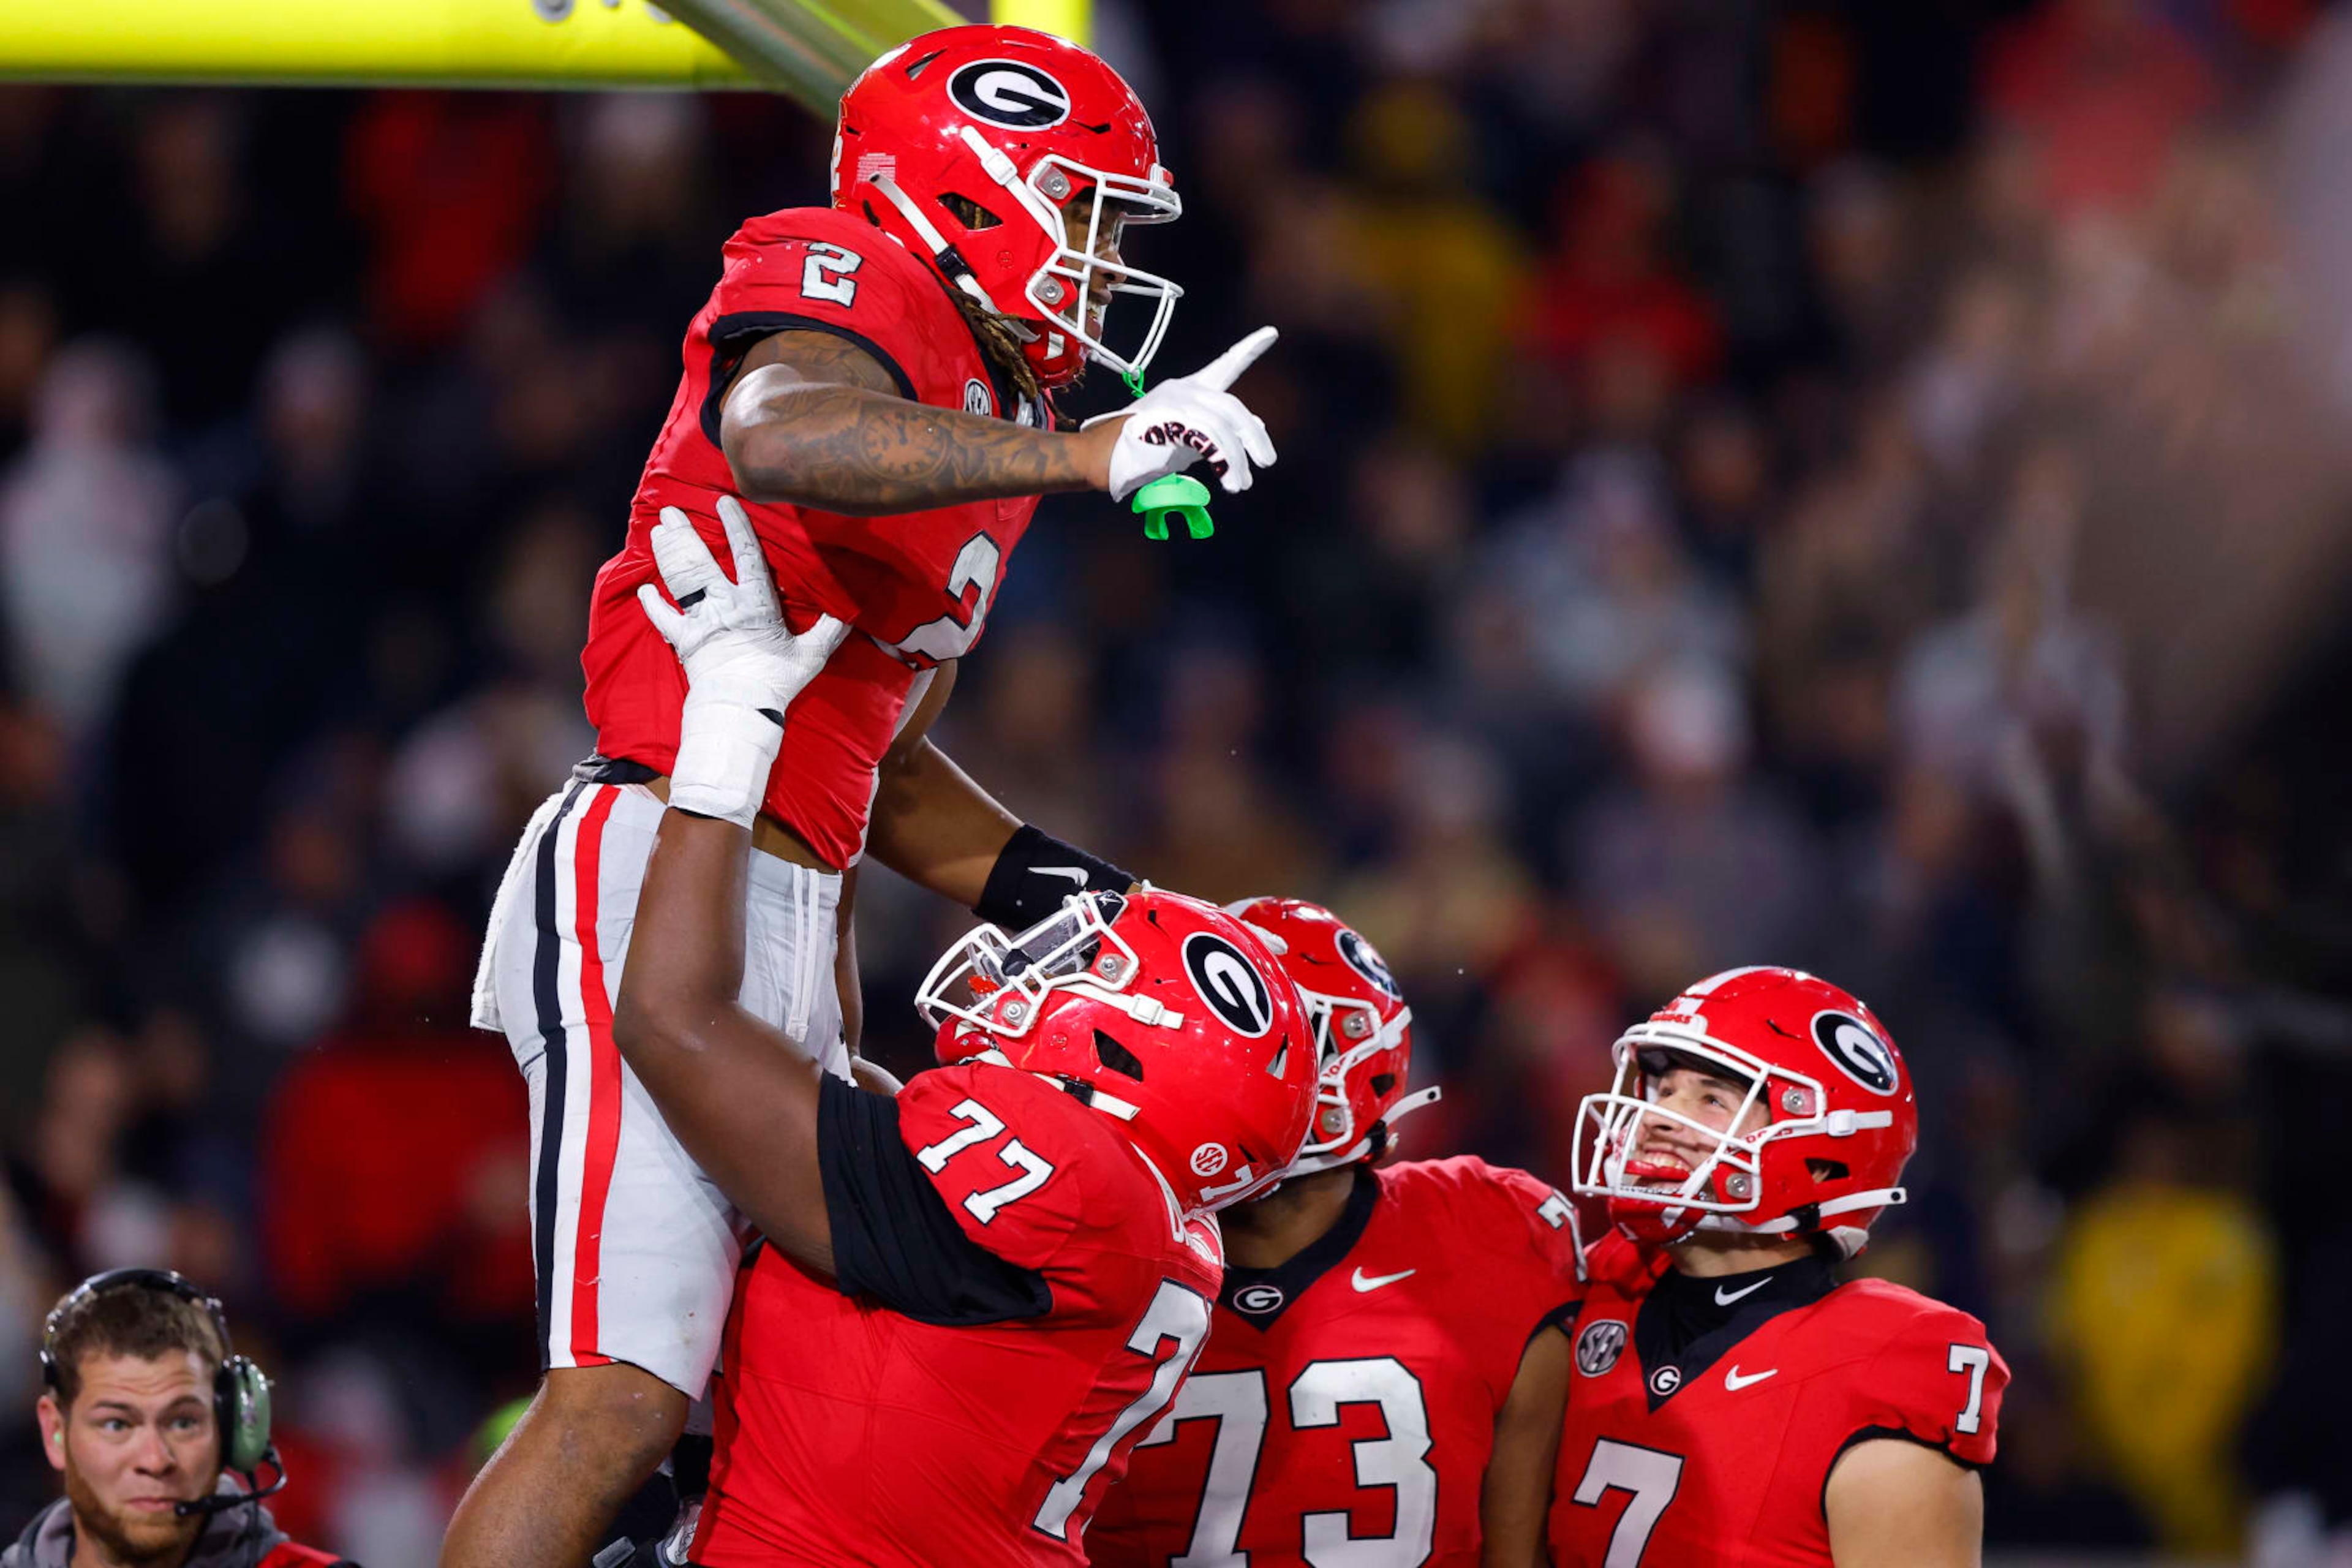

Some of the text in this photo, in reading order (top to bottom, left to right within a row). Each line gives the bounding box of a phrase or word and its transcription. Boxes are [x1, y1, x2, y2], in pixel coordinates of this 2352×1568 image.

[951, 62, 1068, 127] G
[800, 241, 864, 310] 2
[1139, 421, 1229, 480] ORGIA
[1193, 532, 1225, 562] SEC
[891, 529, 1001, 663] 2
[1186, 935, 1269, 1034] G
[1815, 1014, 1894, 1091] G
[916, 1098, 1056, 1226] 77
[1199, 1164, 1254, 1202] 7
[1536, 1187, 1588, 1283] 7
[1236, 1287, 1281, 1312] G
[1578, 1321, 1627, 1376] SEC
[1653, 1368, 1681, 1393] G
[1948, 1343, 1990, 1434] 7
[1132, 1355, 1438, 1568] 73
[1570, 1435, 1686, 1568] 7
